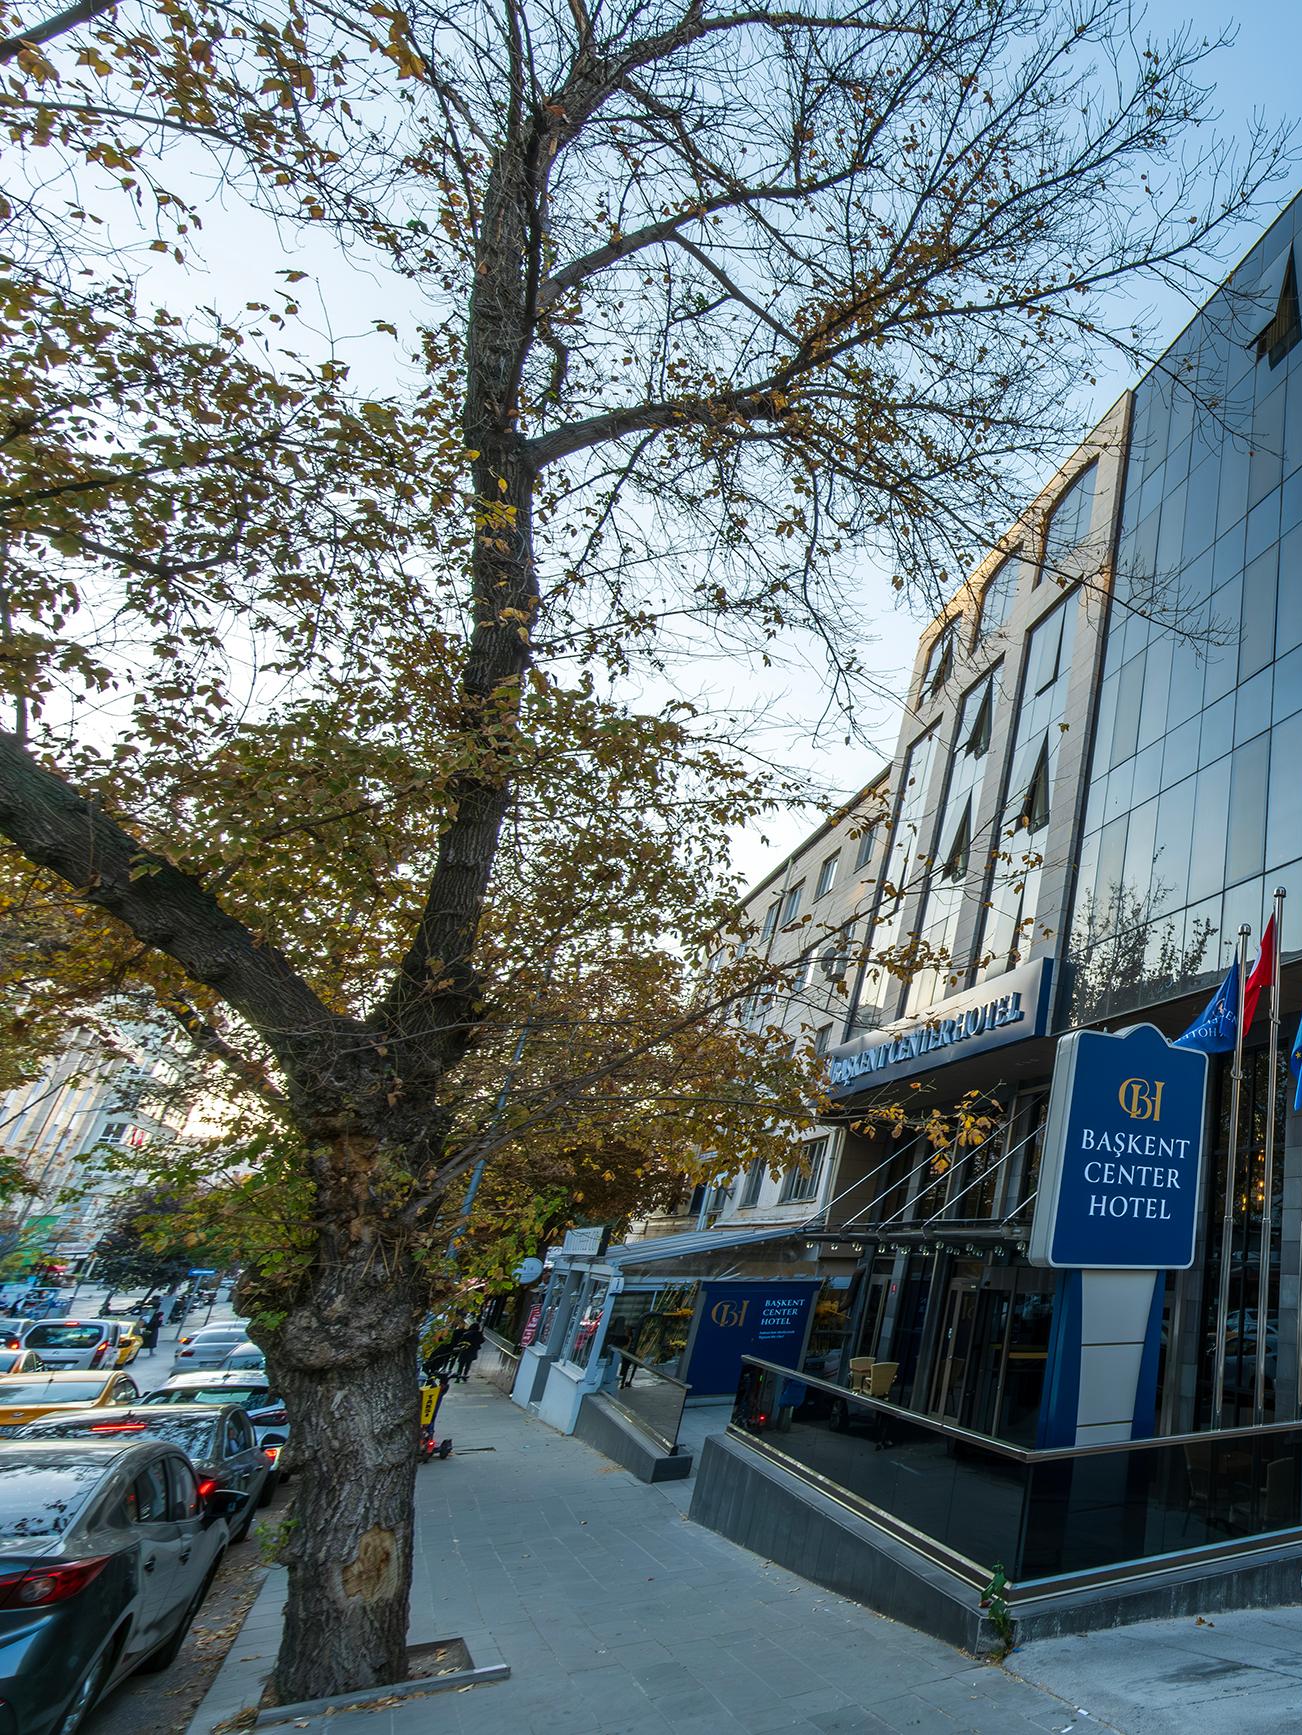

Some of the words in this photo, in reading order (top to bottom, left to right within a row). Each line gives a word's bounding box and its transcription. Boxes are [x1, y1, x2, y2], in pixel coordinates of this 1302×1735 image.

[888, 1018, 956, 1064] CENTER
[953, 992, 1025, 1042] HOTEL
[1081, 1128, 1191, 1159] BAŞKENT
[1084, 1161, 1181, 1189] CENTER
[1088, 1194, 1171, 1220] HOTEL
[762, 1308, 798, 1317] CENTER
[765, 1298, 805, 1308] BAŞKENT
[760, 1317, 791, 1326] HOTEL
